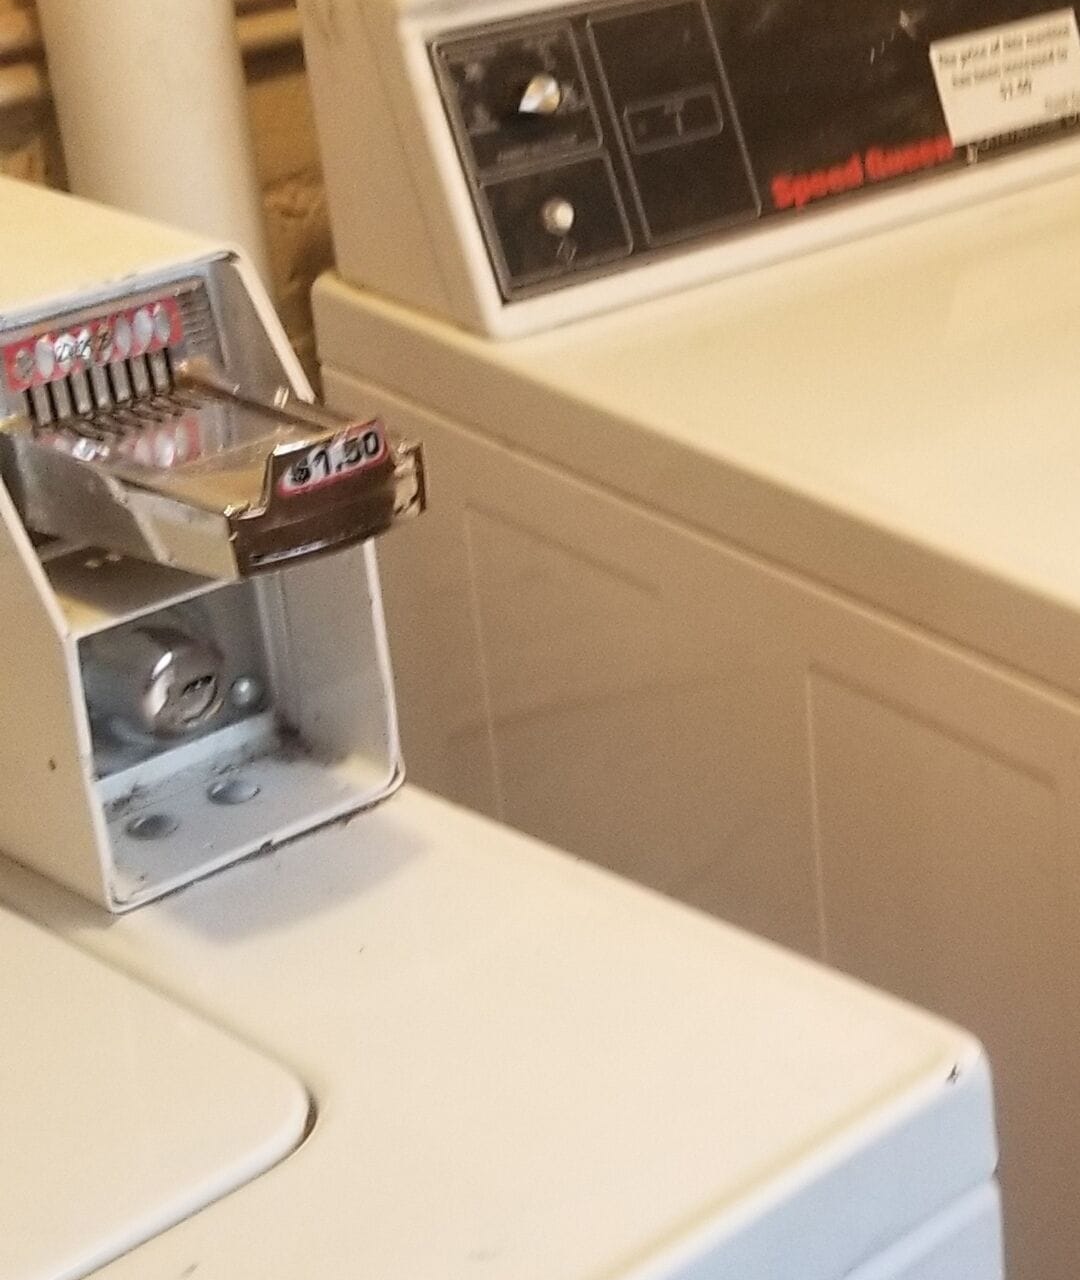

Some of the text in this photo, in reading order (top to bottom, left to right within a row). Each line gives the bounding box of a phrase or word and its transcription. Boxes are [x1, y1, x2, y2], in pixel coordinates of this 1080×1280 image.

[771, 133, 955, 210] Speed Queen
[289, 430, 380, 485] $1.50
